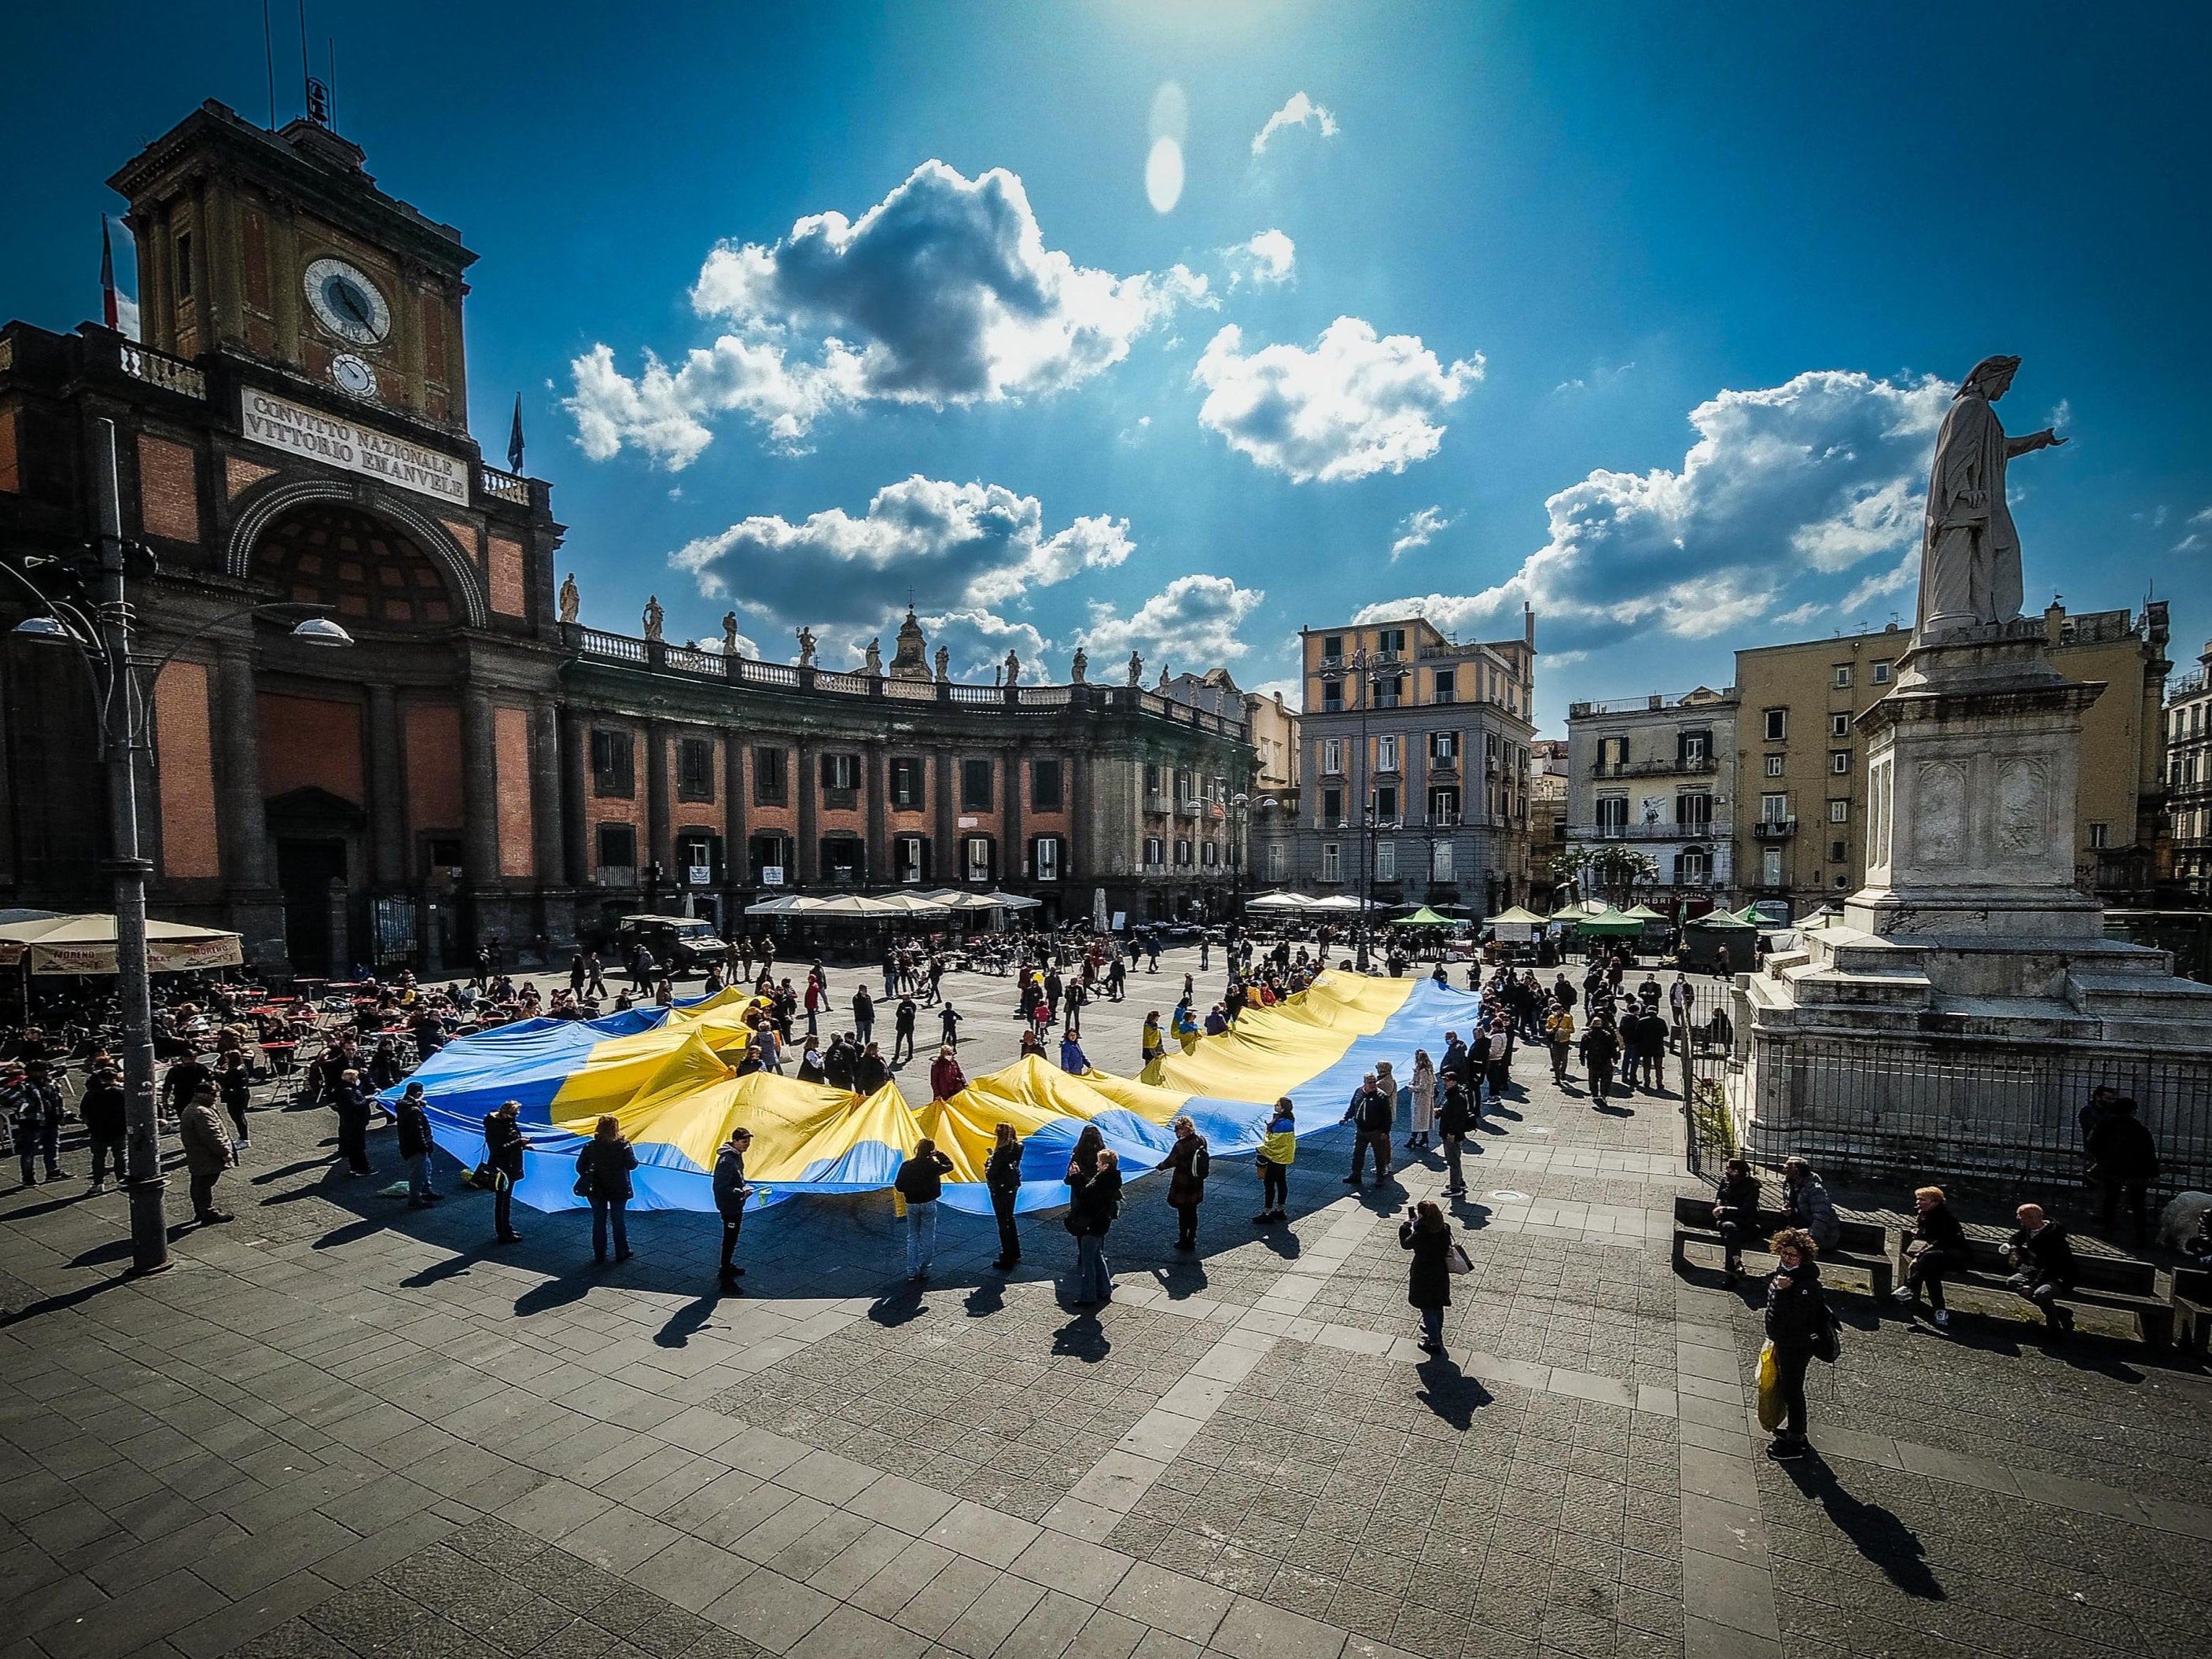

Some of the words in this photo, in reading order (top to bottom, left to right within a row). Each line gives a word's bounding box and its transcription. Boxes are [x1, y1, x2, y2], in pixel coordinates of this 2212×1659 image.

[245, 412, 354, 462] VITTORIO
[361, 449, 464, 498] EMANVELE
[253, 396, 351, 441] CONVITTO
[356, 430, 453, 476] NAZIONALE
[53, 950, 95, 959] MORENO
[193, 945, 228, 956] MORENO
